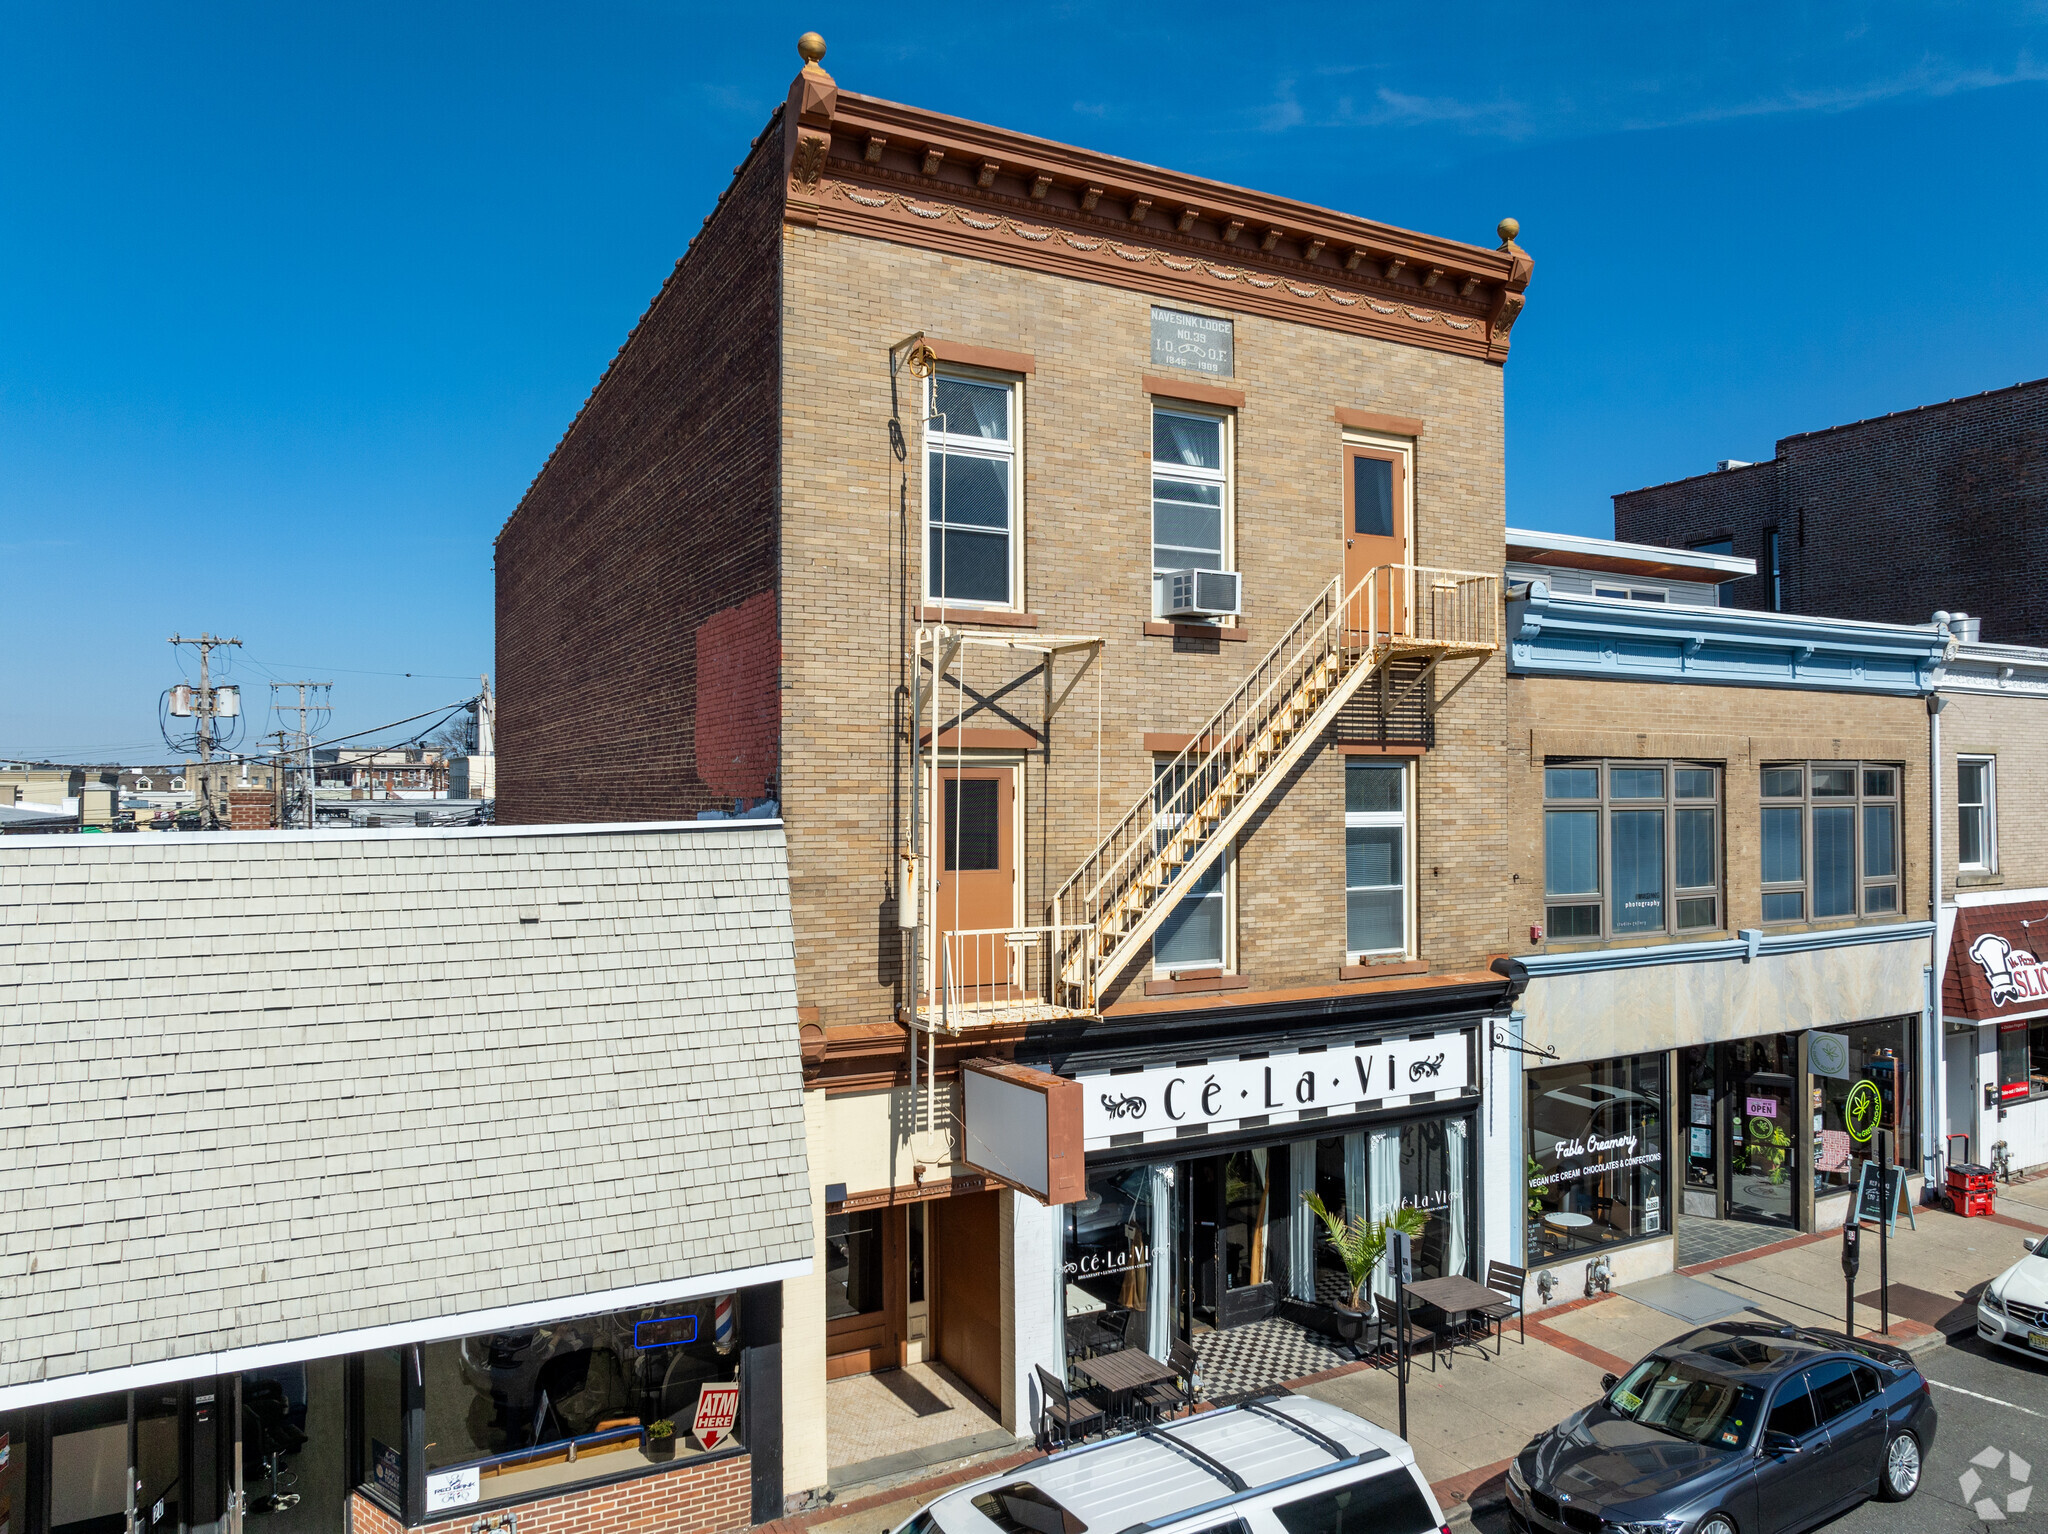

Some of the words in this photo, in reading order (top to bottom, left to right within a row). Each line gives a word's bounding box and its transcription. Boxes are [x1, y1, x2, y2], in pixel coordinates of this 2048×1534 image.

[1151, 310, 1198, 327] NAVESINK
[1625, 900, 1660, 909] photography
[1264, 1066, 1315, 1109] La
[1751, 1104, 1772, 1114] OPEN
[1555, 1138, 1585, 1159] Fable
[1587, 1135, 1638, 1155] Creamery
[1529, 1175, 1550, 1188] VEGAN
[1550, 1173, 1560, 1183] ICE
[1560, 1168, 1581, 1181] CREAM
[1583, 1160, 1619, 1175] CHOCOLATES
[1620, 1159, 1625, 1168] &
[1625, 1152, 1662, 1167] CONFECTIONS
[1108, 1251, 1126, 1268] La
[699, 1392, 736, 1417] ATM
[697, 1416, 732, 1428] HERE
